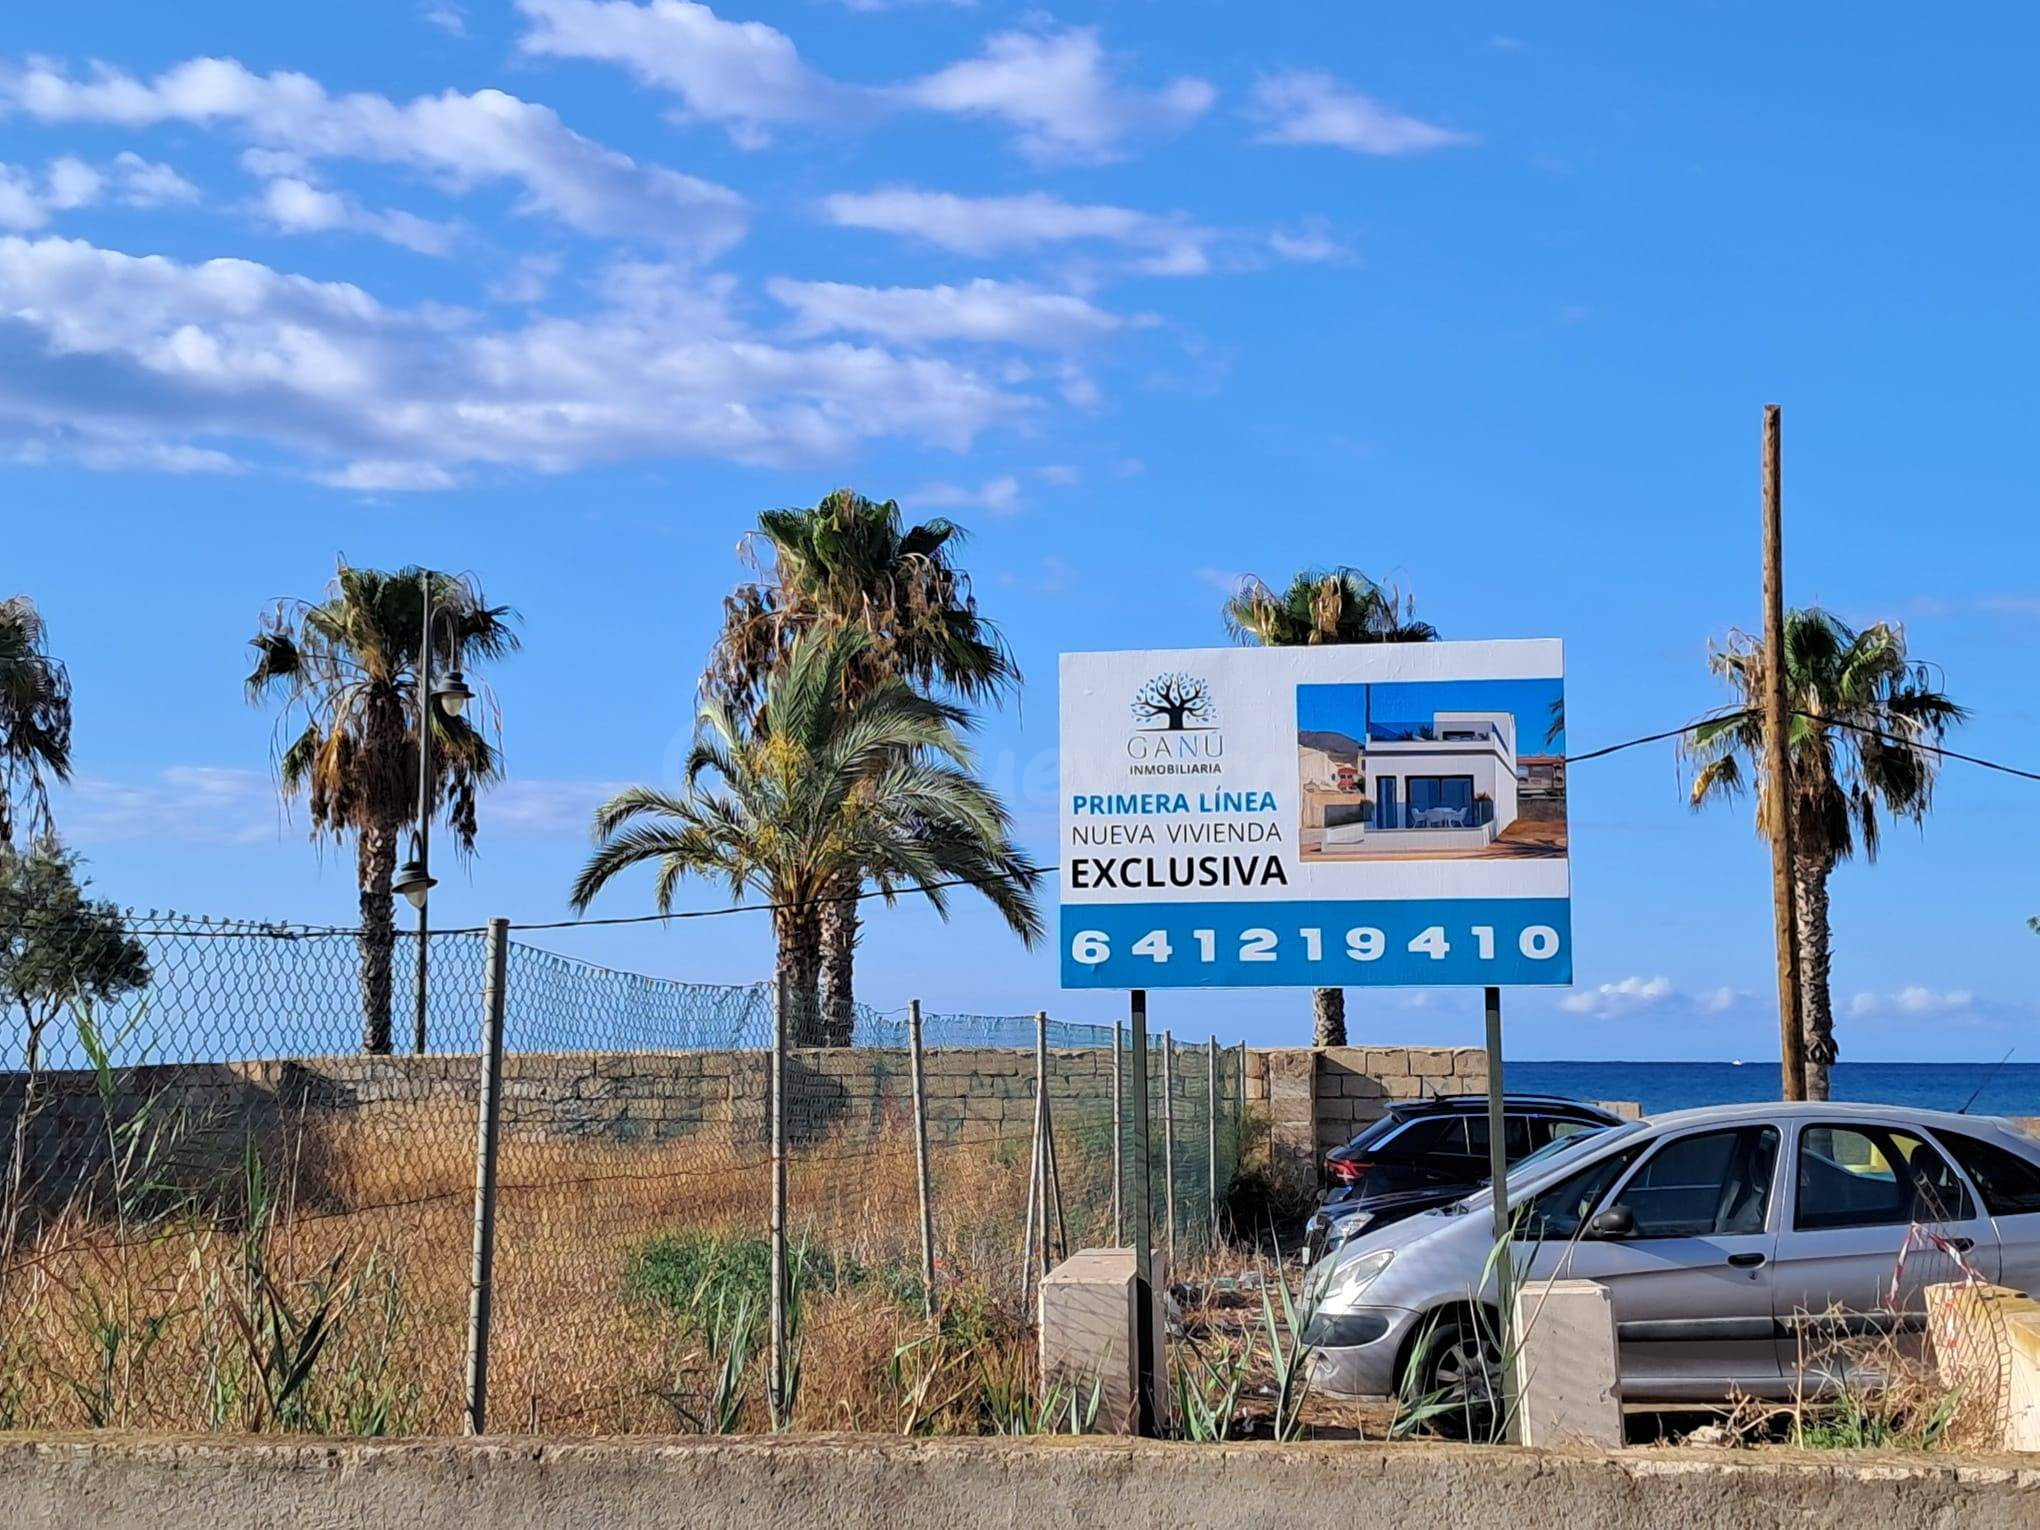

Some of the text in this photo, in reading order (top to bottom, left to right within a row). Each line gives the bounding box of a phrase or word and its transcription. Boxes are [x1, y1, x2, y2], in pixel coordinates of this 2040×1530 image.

[1129, 763, 1222, 776] INMOBILIARIA
[1073, 785, 1277, 815] PRIMERA LÍNEA
[1072, 822, 1282, 845] NUEVA VIVIENDA
[1071, 856, 1289, 888] EXCLUSIVA
[1071, 925, 1560, 964] 641219410
